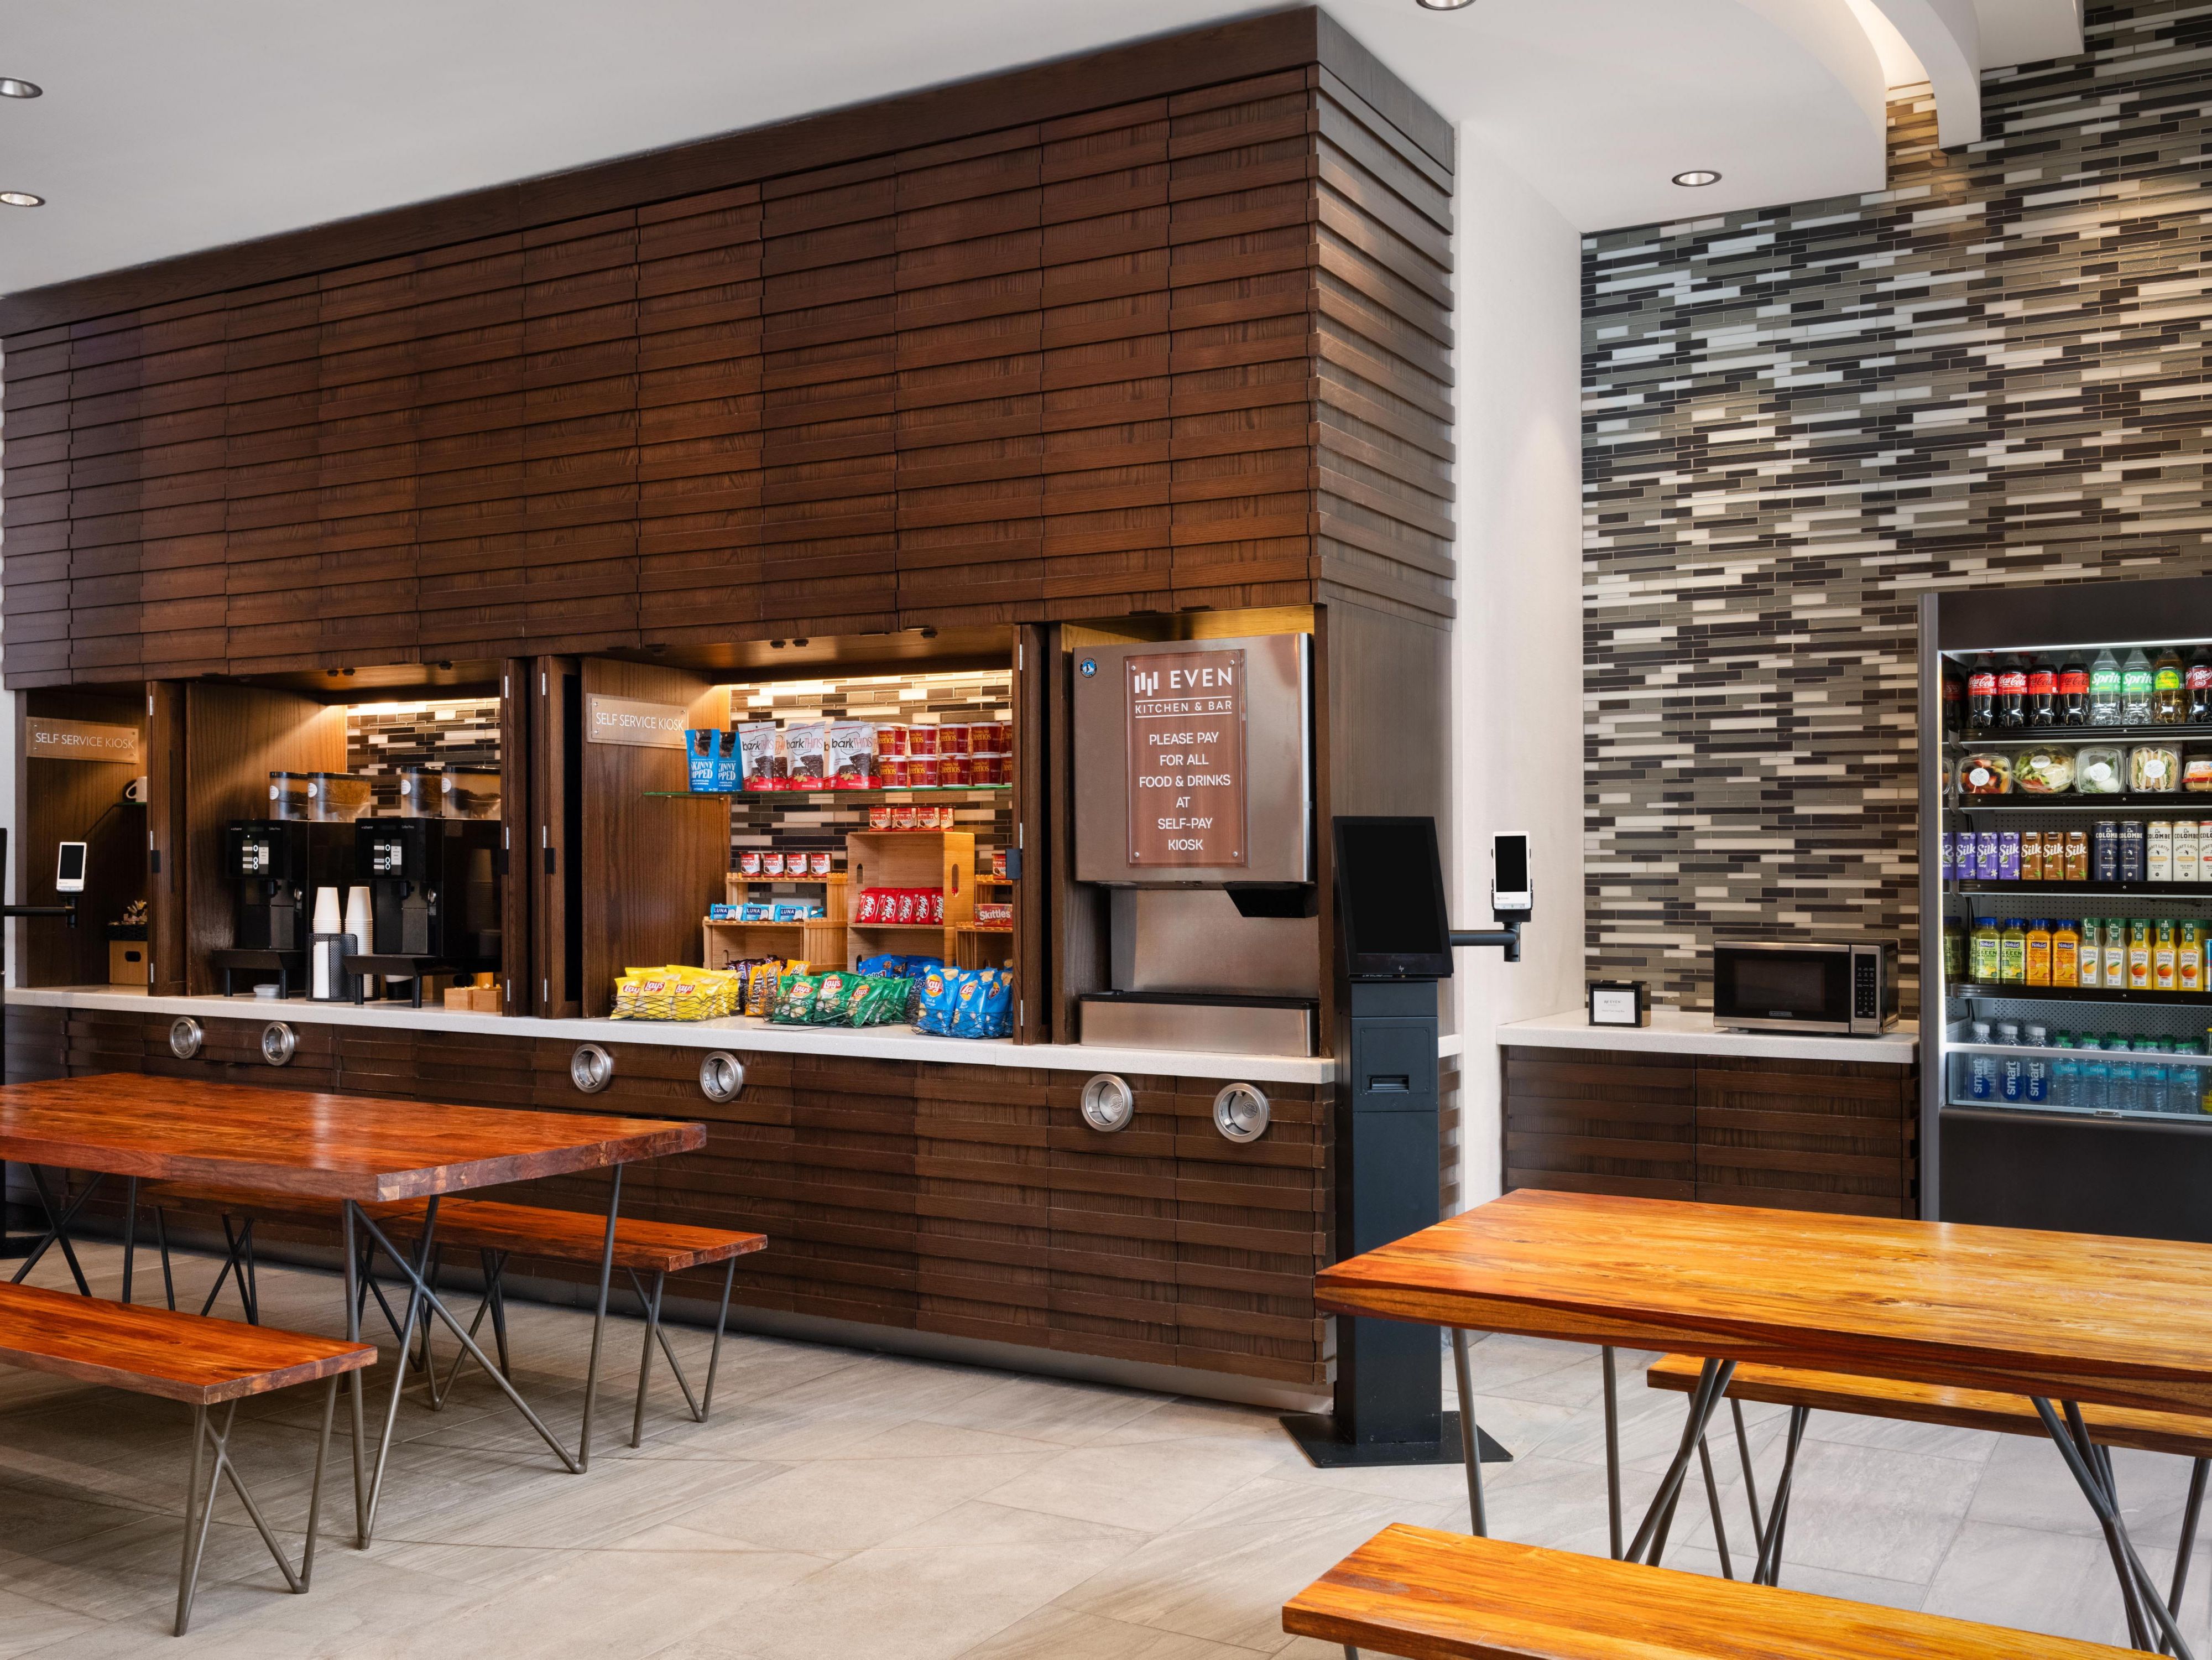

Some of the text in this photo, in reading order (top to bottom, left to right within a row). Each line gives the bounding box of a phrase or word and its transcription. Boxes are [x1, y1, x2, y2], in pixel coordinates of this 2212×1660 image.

[1170, 667, 1232, 689] EVEN
[1968, 675, 1996, 688] Coca-Cola
[1998, 674, 2027, 687] Coca-Cola
[2193, 672, 2211, 681] Pepper
[1135, 700, 1232, 714] KITCHEN & BAR
[596, 712, 684, 731] SELF SERVICE KIOSK
[35, 732, 134, 749] SELF SERVICE KIOSK
[1149, 732, 1219, 745] PLEASE PAY
[1160, 753, 1209, 766] FOR ALL
[1139, 774, 1231, 788] FOOD & DRINKS
[1176, 797, 1191, 808] AT
[1157, 818, 1213, 830] SELF-PAY
[1168, 839, 1203, 851] KIOSK
[1956, 843, 1975, 857] Silk
[1977, 843, 1997, 857] Silk
[1999, 843, 2020, 857] Silk
[2021, 843, 2042, 857] Silk
[2043, 843, 2064, 857] Silk
[2065, 843, 2088, 857] Silk
[979, 909, 1011, 921] Skittles
[1973, 1058, 1983, 1093] smart
[2006, 1060, 2016, 1095] smart
[2029, 1062, 2039, 1097] smart
